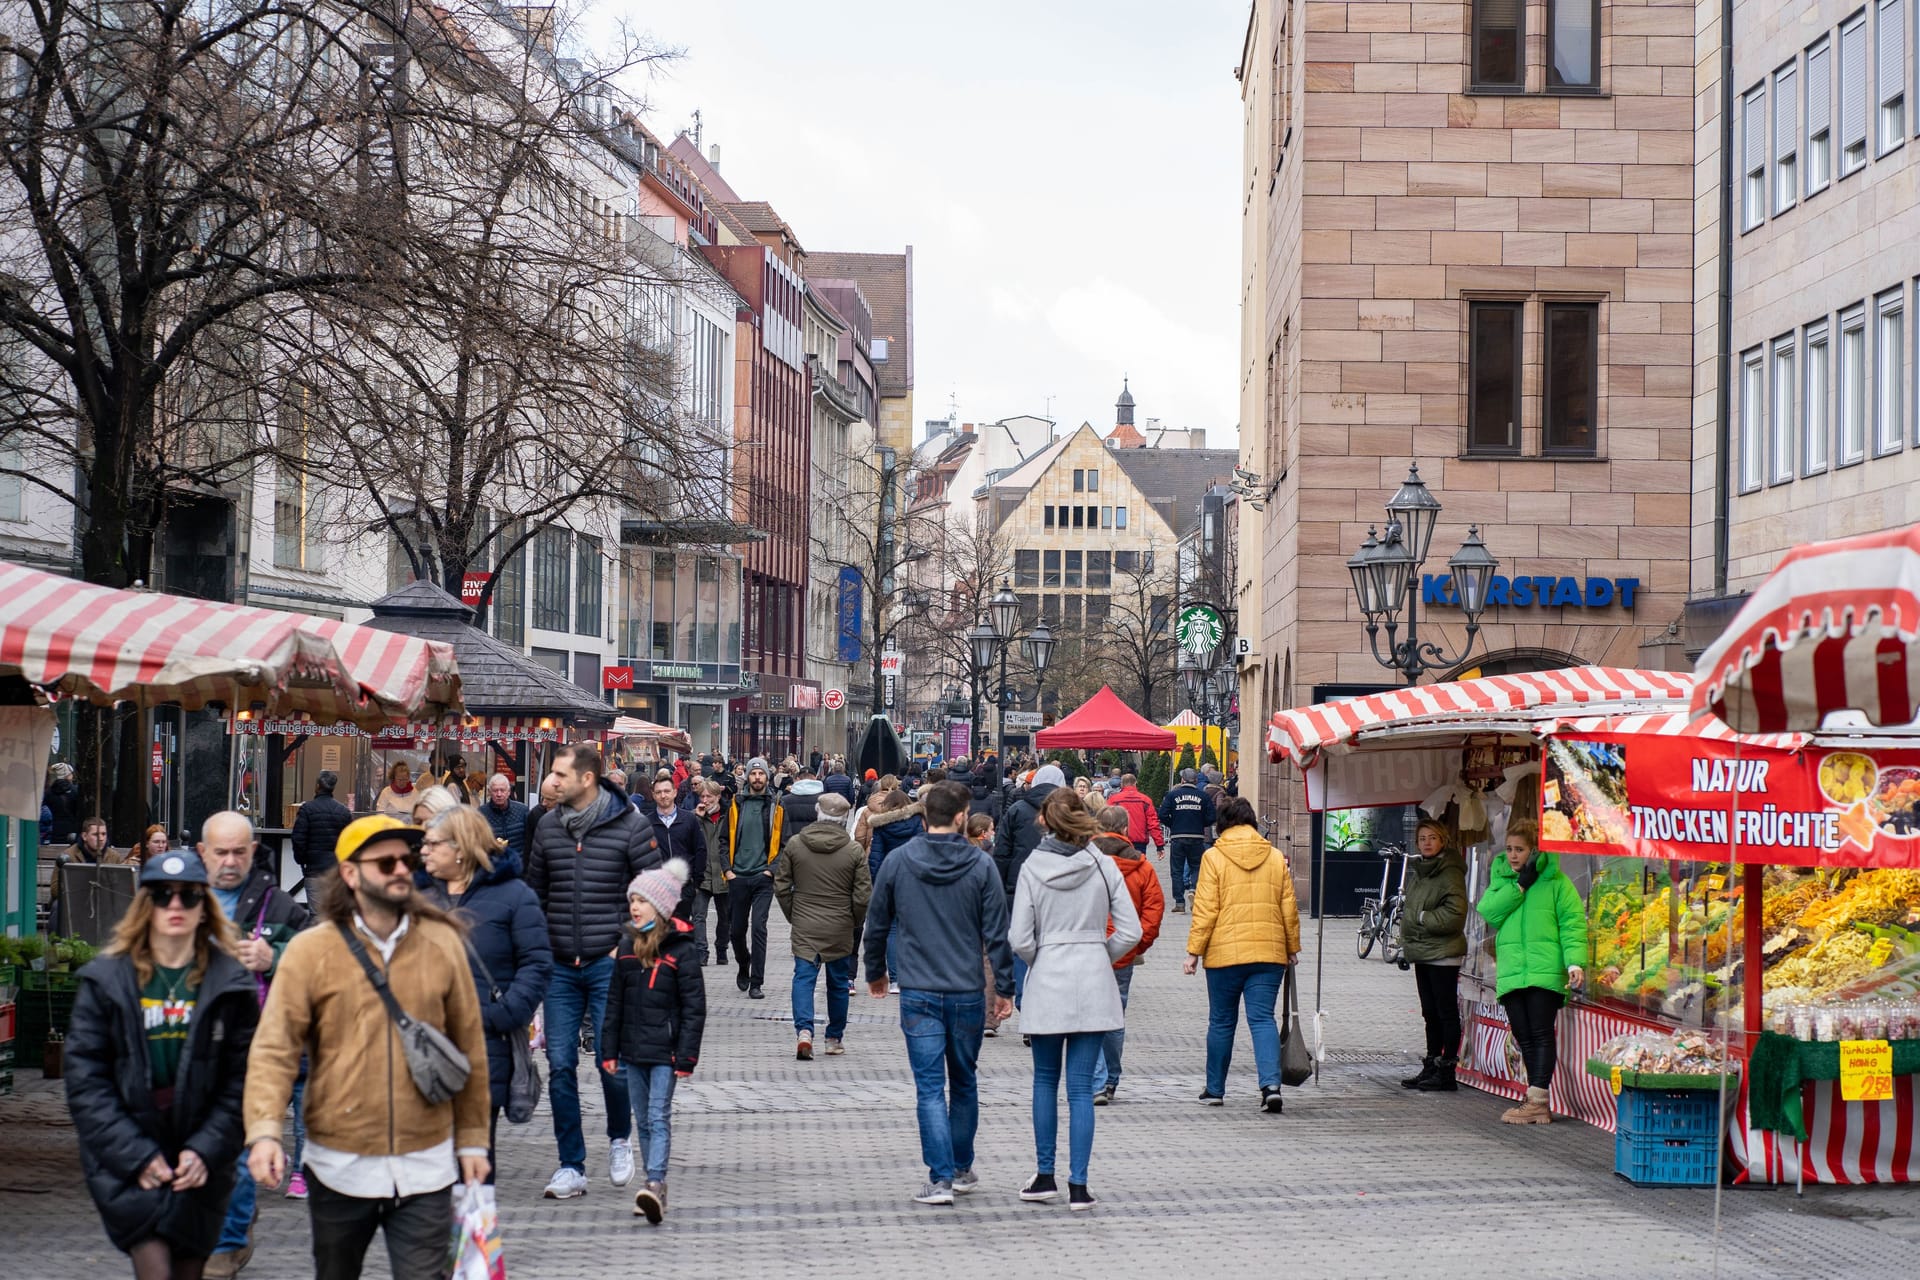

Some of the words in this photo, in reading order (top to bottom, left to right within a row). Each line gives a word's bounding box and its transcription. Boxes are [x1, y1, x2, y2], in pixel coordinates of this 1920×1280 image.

[1239, 638, 1248, 653] B
[885, 675, 894, 706] GERRY
[235, 721, 261, 733] Orig.
[1692, 758, 1769, 793] NATUR
[1630, 805, 1729, 844] TROCKEN
[1734, 803, 1841, 849] FRÜCHTE
